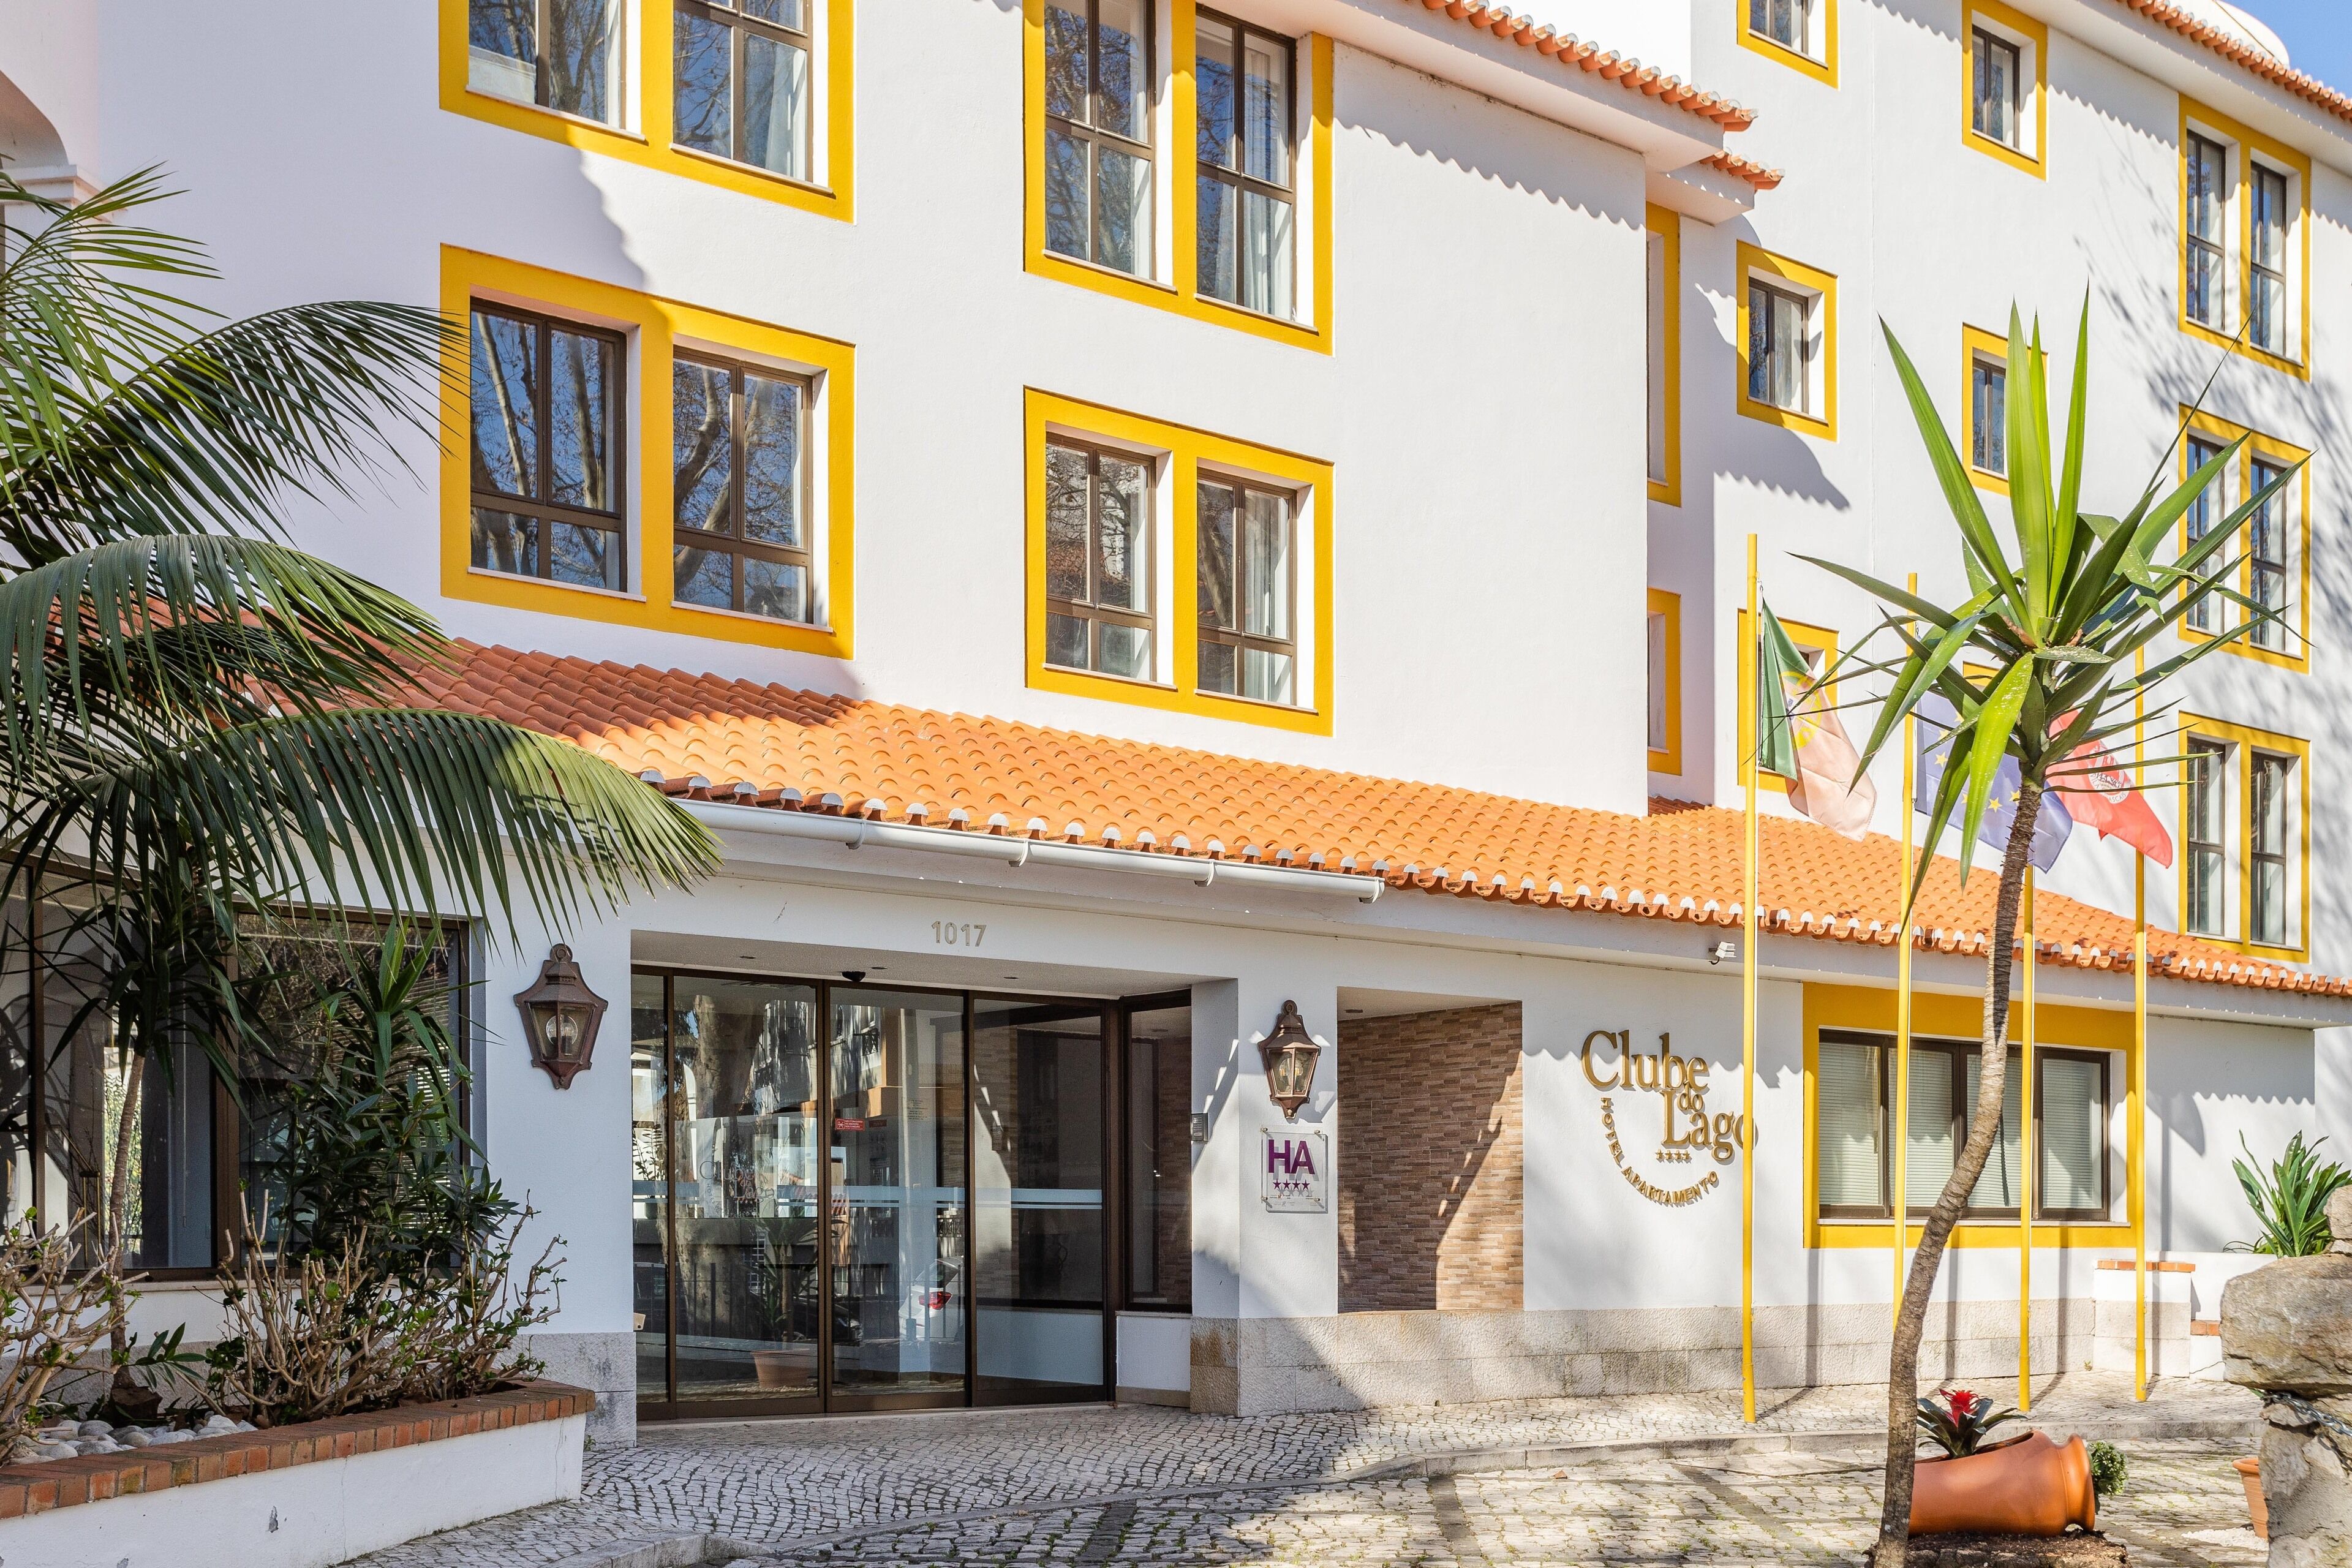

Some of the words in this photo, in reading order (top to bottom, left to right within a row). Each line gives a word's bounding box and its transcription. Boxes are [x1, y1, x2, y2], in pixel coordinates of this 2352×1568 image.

[931, 920, 987, 947] 1017
[1581, 1029, 1709, 1091] Clube
[1677, 1080, 1705, 1112] do
[1268, 1139, 1316, 1175] HA
[1600, 1097, 1624, 1166] HOTEL
[1621, 1166, 1719, 1204] APARTAMENTO
